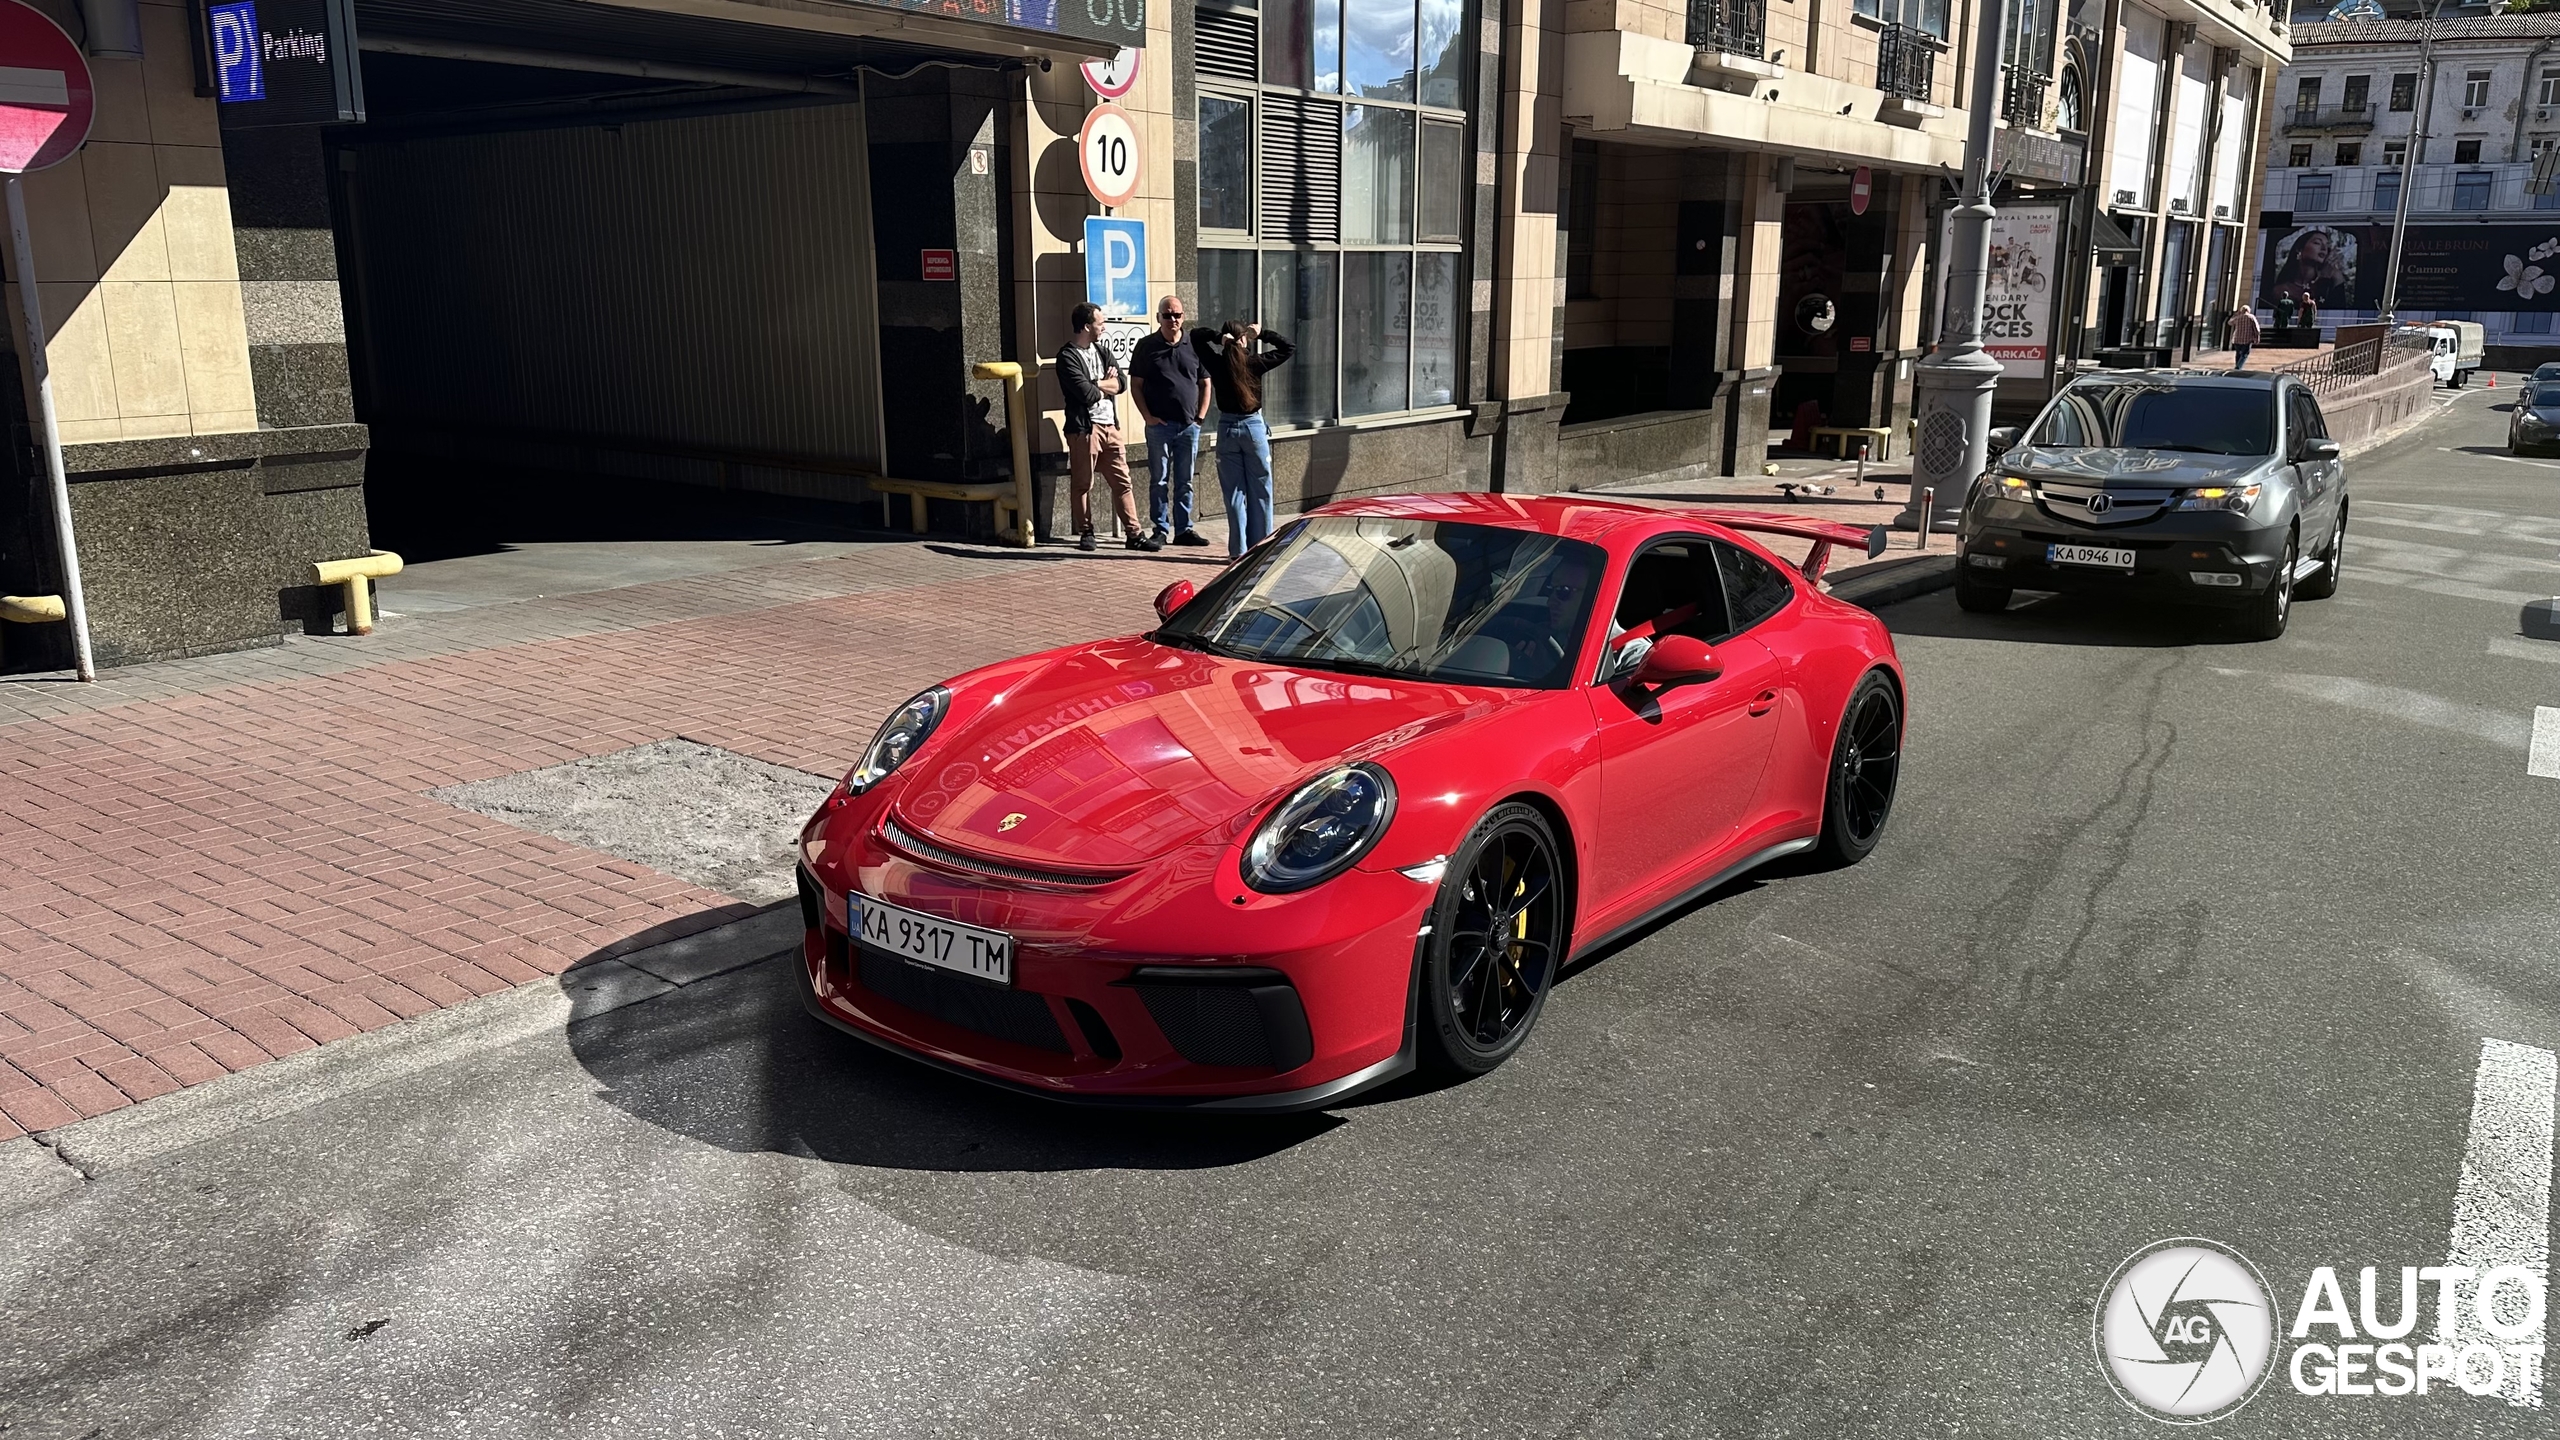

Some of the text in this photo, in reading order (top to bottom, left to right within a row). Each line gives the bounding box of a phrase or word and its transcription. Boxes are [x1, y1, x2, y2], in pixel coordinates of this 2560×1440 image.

[262, 27, 326, 64] Parking
[1097, 134, 1126, 176] 10
[1103, 229, 1136, 310] P
[2407, 264, 2458, 275] Cammeo
[1982, 303, 2027, 321] OCK
[1113, 337, 1126, 352] 25
[2055, 547, 2075, 560] KA
[2078, 549, 2109, 563] 0946
[1498, 807, 1529, 819] MICHELIN
[861, 903, 1005, 976] KA 9317 TM
